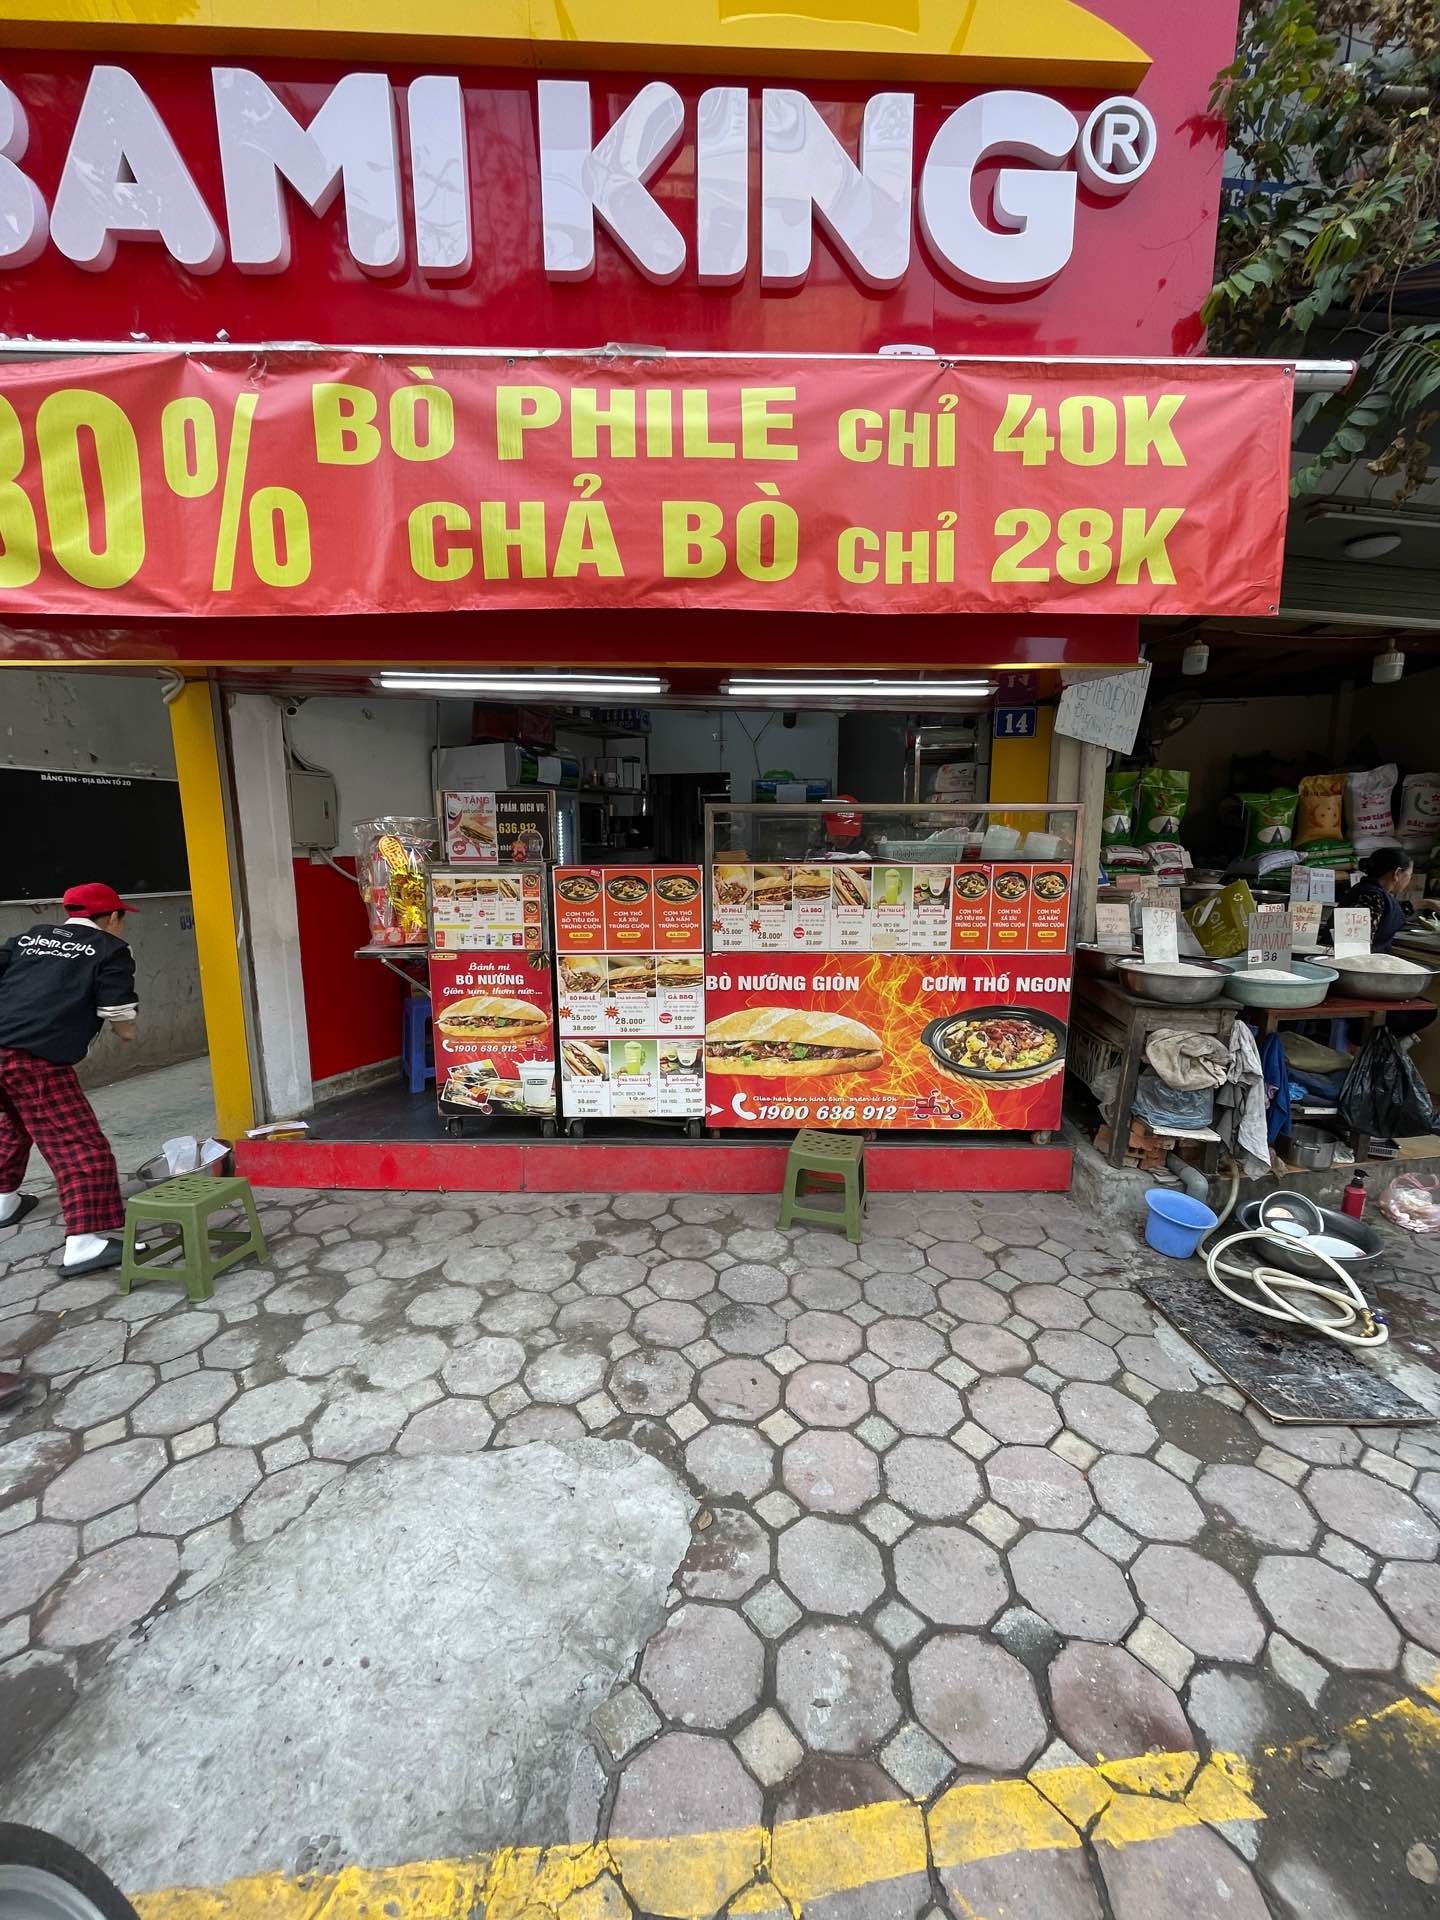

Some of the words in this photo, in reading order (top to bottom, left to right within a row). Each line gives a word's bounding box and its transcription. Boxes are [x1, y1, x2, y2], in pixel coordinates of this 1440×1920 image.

[537, 80, 1079, 294] KING
[311, 366, 455, 466] BÒ
[496, 384, 799, 461] PHILE
[837, 393, 958, 468] CHỈ
[993, 394, 1187, 468] 40K
[407, 473, 625, 582] CHẢ
[663, 482, 799, 582] BÒ
[837, 510, 958, 586] CHỈ
[992, 507, 1187, 586] 28K
[1004, 712, 1029, 734] 14
[64, 775, 78, 784] TIN
[122, 779, 132, 787] 20
[1263, 951, 1278, 962] 38
[455, 972, 474, 985] BÒ
[706, 972, 732, 991] BÒ
[738, 972, 806, 991] NƯỚNG
[812, 972, 860, 991] GIÒN
[921, 974, 967, 992] CƠM
[972, 971, 1010, 992] THỐ
[1015, 975, 1071, 992] NGON
[454, 1044, 478, 1053] 1900
[757, 1105, 809, 1120] 1900
[815, 1105, 856, 1120] 636
[862, 1105, 897, 1120] 912
